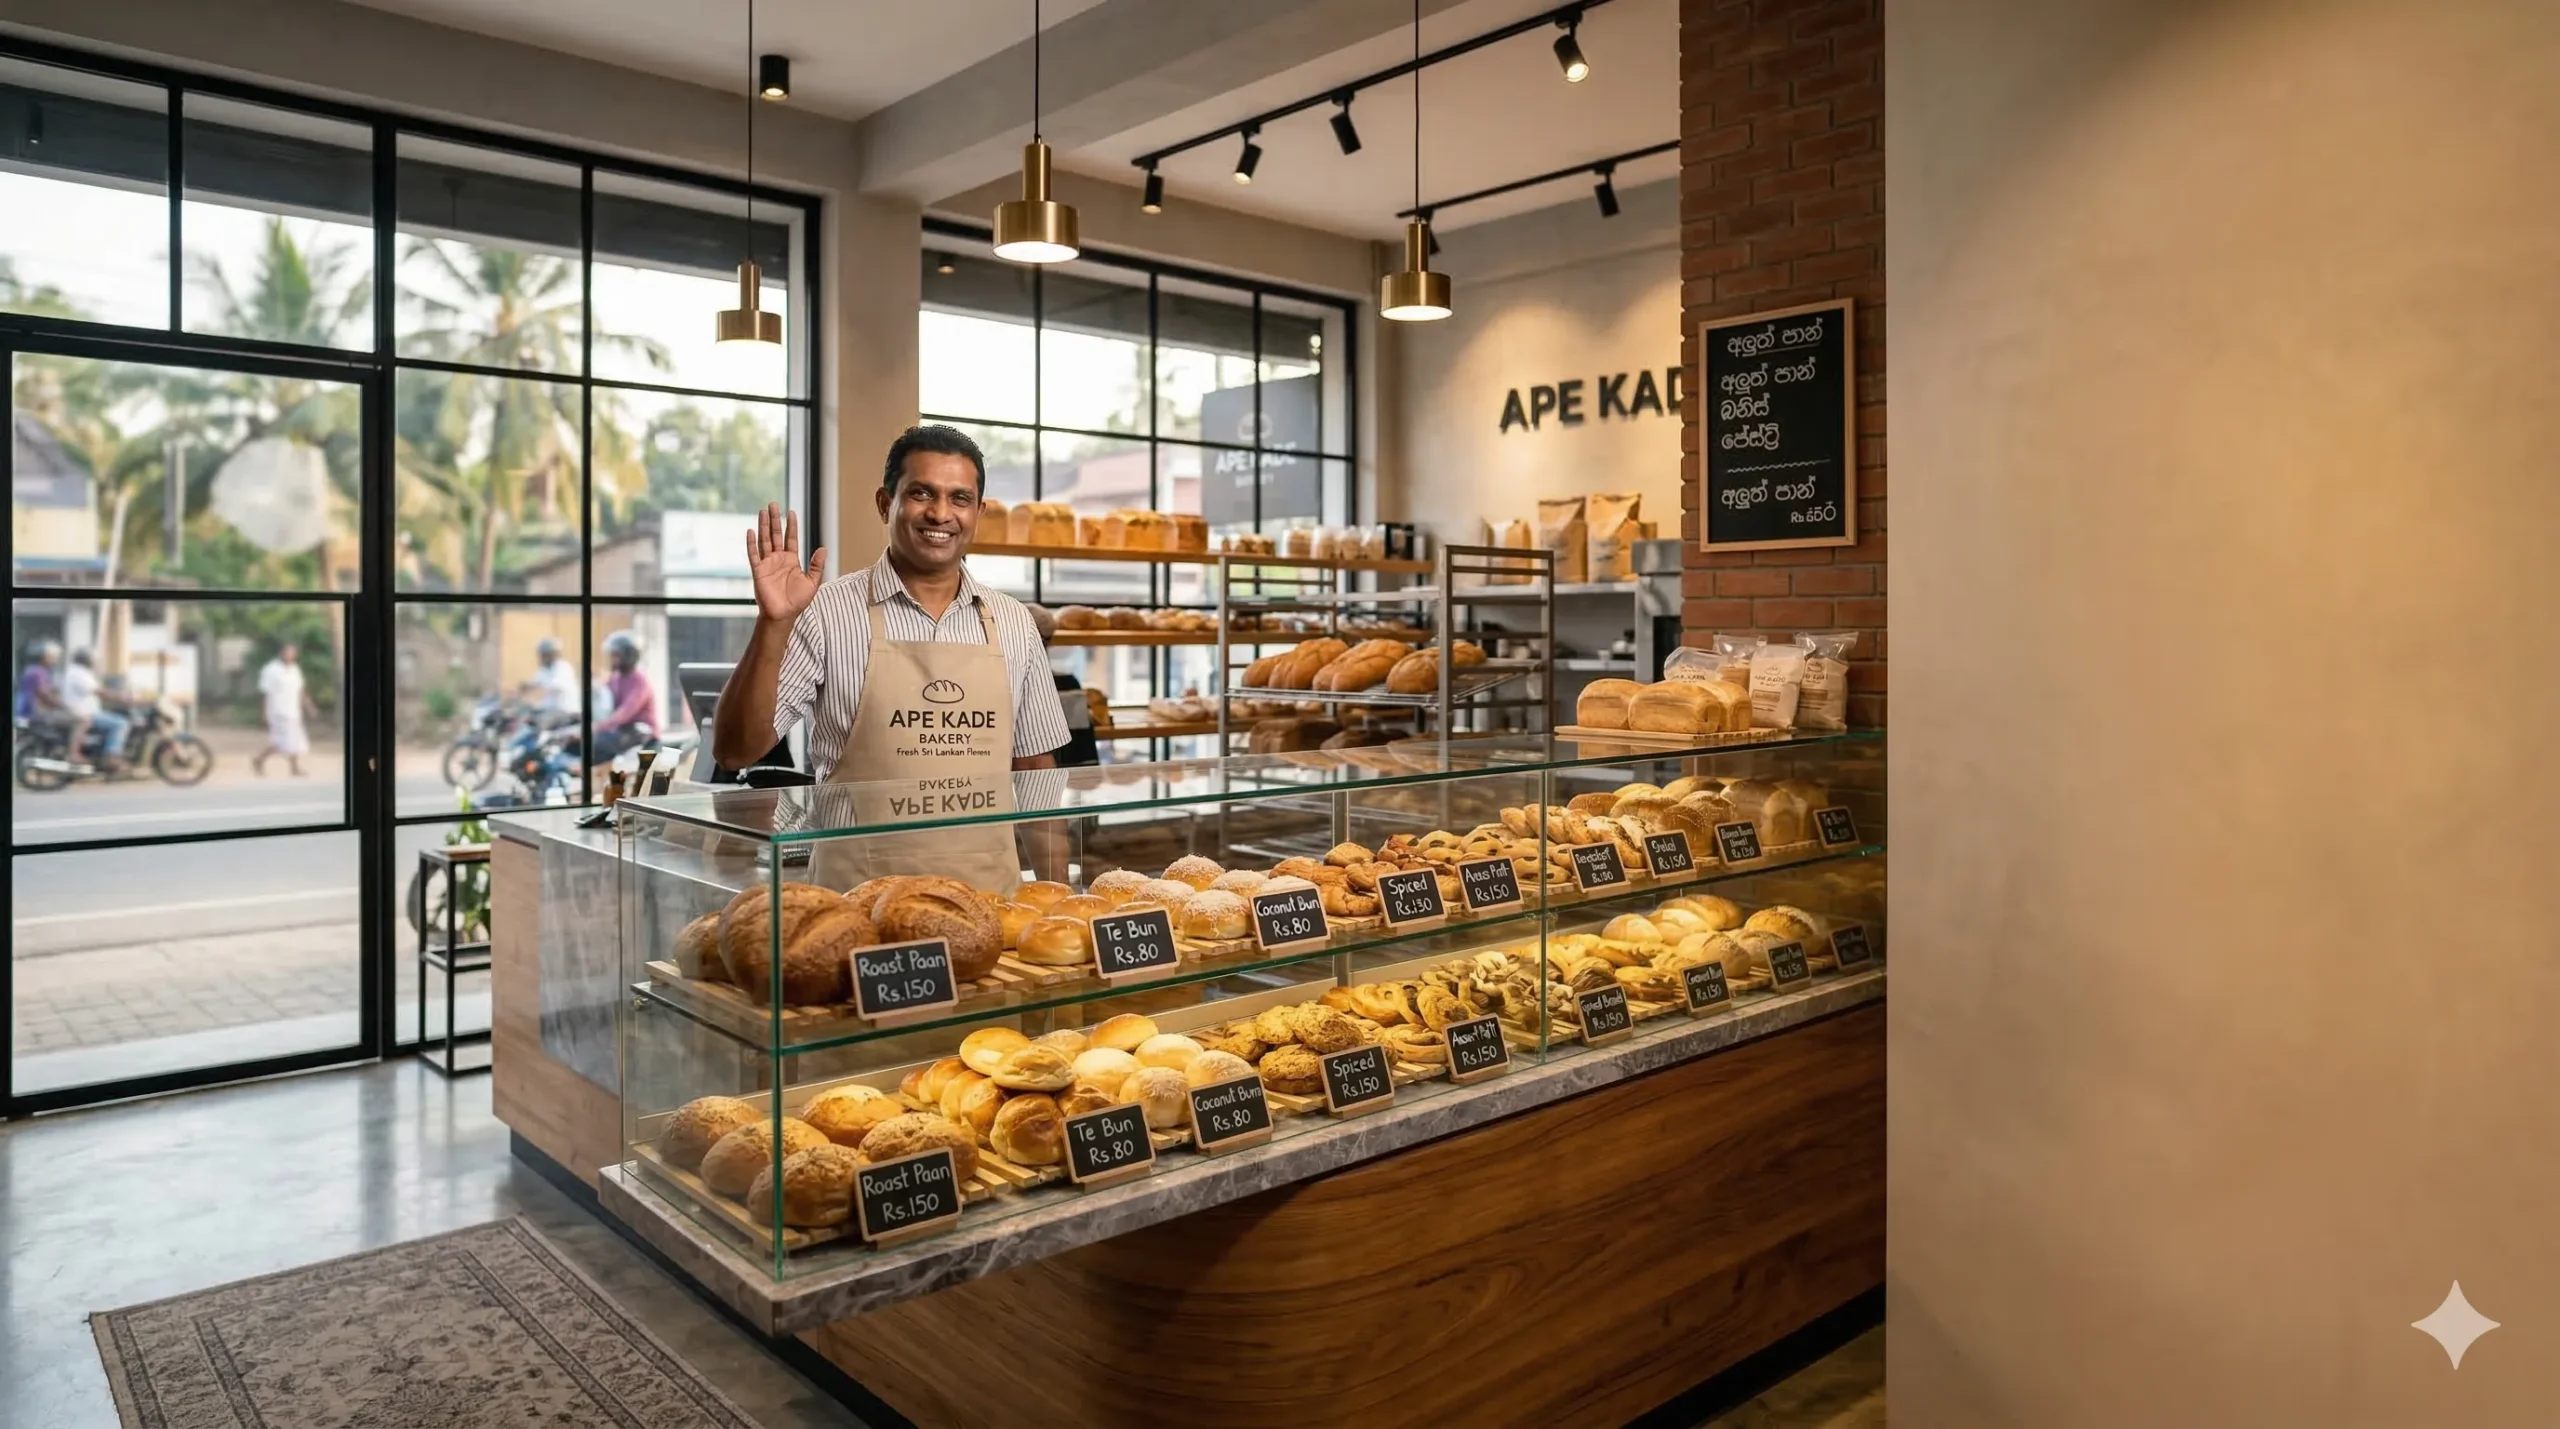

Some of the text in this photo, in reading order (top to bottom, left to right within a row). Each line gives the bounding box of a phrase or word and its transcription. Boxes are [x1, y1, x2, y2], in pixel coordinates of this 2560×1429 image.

[1499, 379, 1584, 434] APE
[889, 710, 996, 728] APE KADE
[919, 734, 972, 744] BAKERY
[897, 747, 919, 756] Fresh
[922, 747, 933, 756] Sri
[935, 747, 965, 756] Lankan
[1388, 873, 1428, 900] Spiced
[1256, 895, 1320, 917] Coconut Bun
[1101, 920, 1158, 942] Te Bun
[1272, 917, 1311, 938] Rs.80
[858, 950, 946, 978] Roast Paan
[1114, 943, 1159, 966] Rs.80
[877, 979, 936, 1004] Rs.150
[1195, 1087, 1237, 1111] Coconut
[1073, 1117, 1134, 1143] Te Bun
[1212, 1109, 1251, 1132] Rs.80
[1089, 1139, 1134, 1166] Rs.80
[862, 1163, 950, 1198] Roast Paan
[882, 1193, 939, 1224] Rs.150
